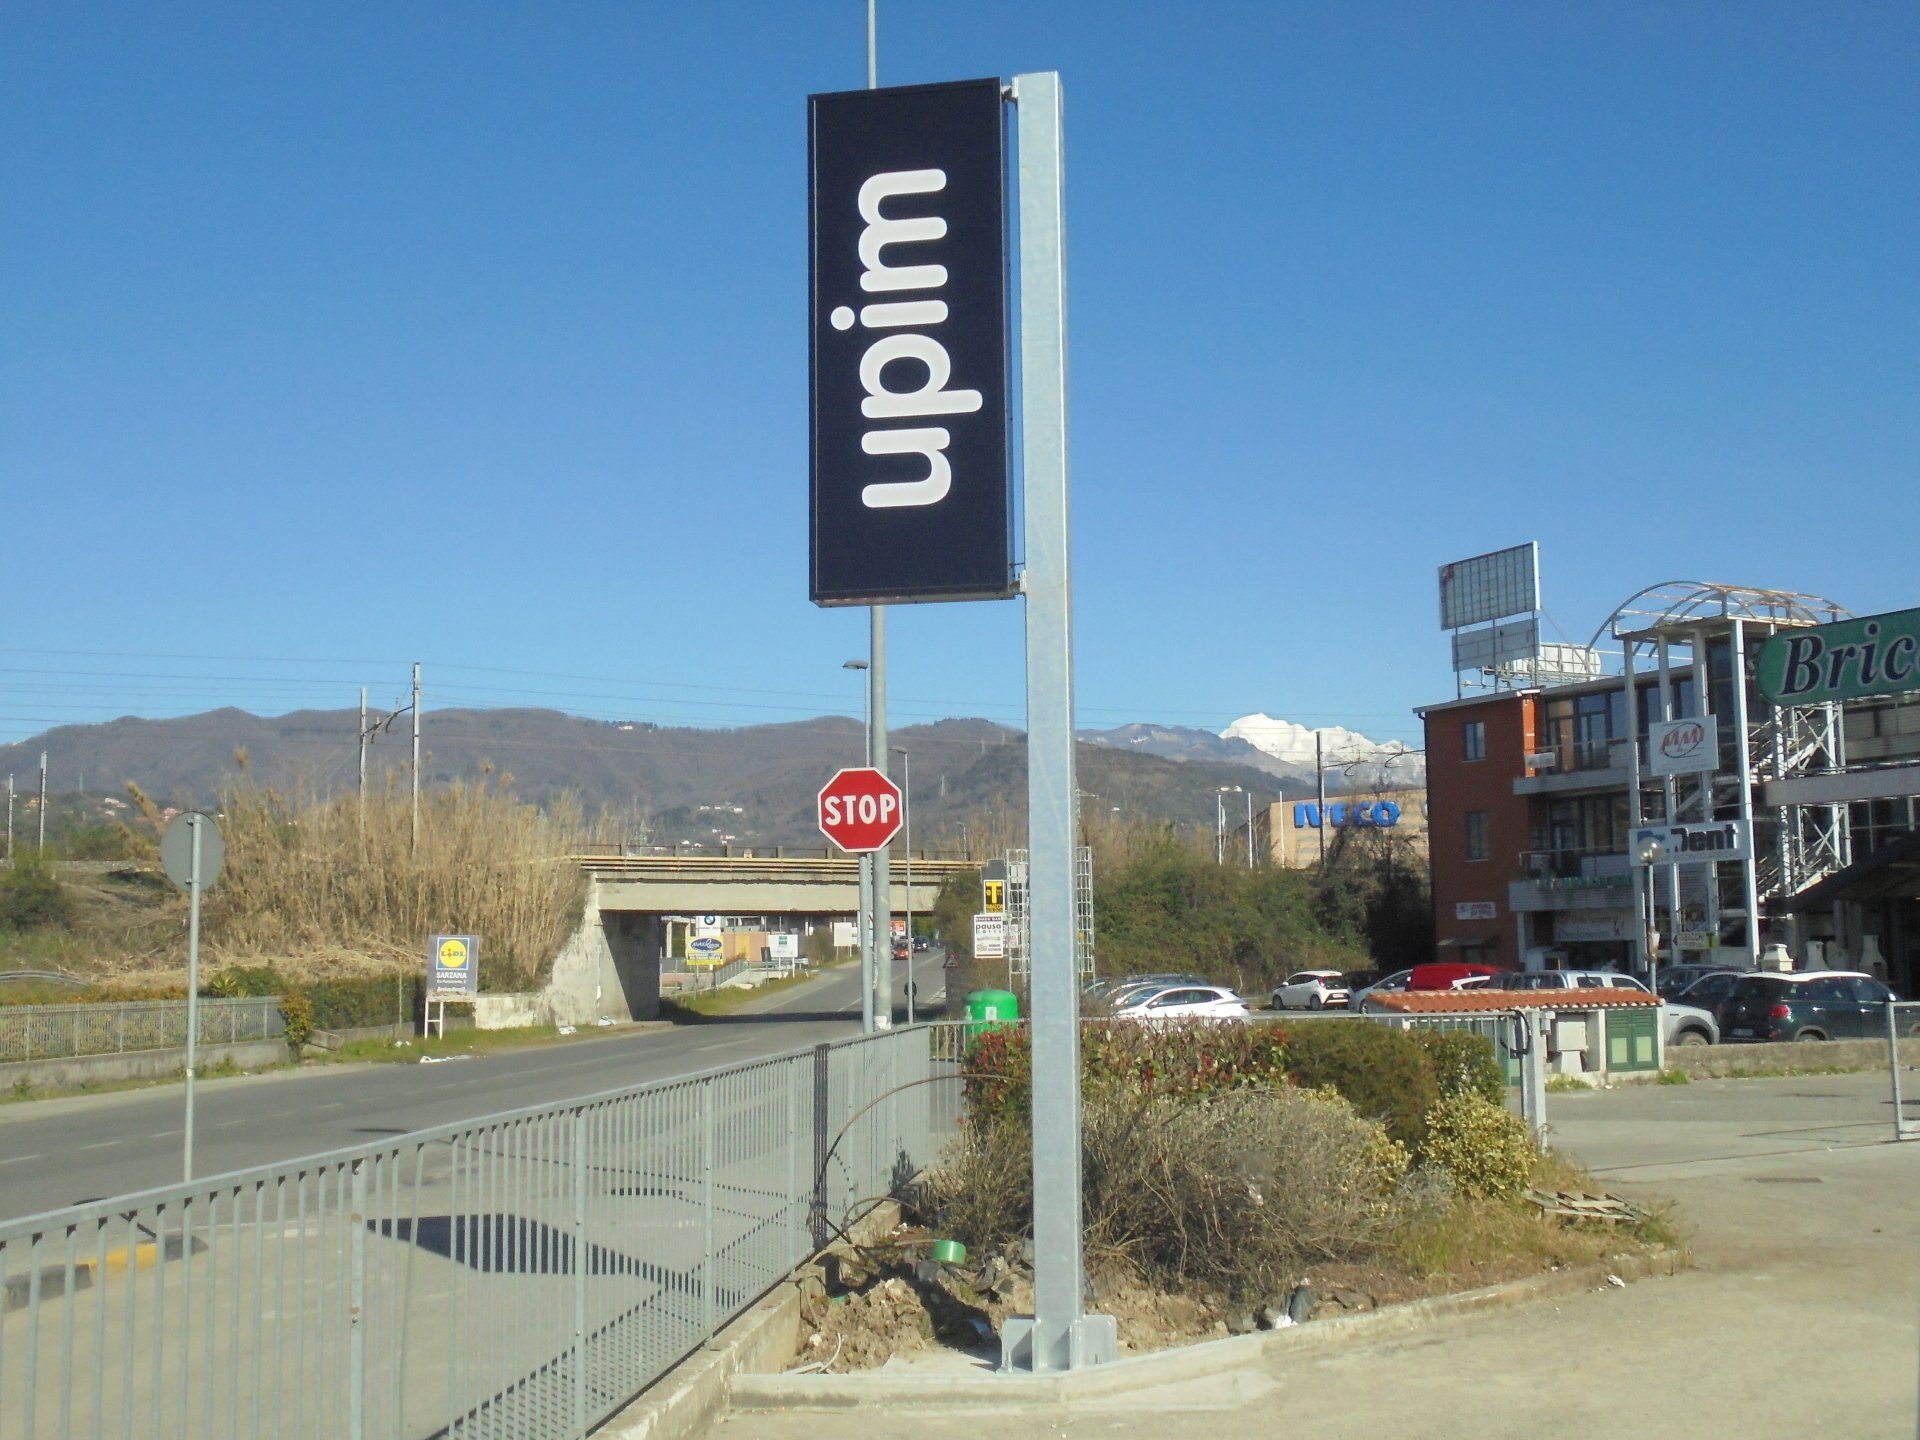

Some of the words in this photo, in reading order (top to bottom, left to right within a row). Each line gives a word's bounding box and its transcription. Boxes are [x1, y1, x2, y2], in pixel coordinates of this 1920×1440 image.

[830, 168, 983, 508] upim
[1778, 621, 1920, 697] Bric
[824, 793, 896, 826] STOP
[976, 924, 1001, 932] pausa
